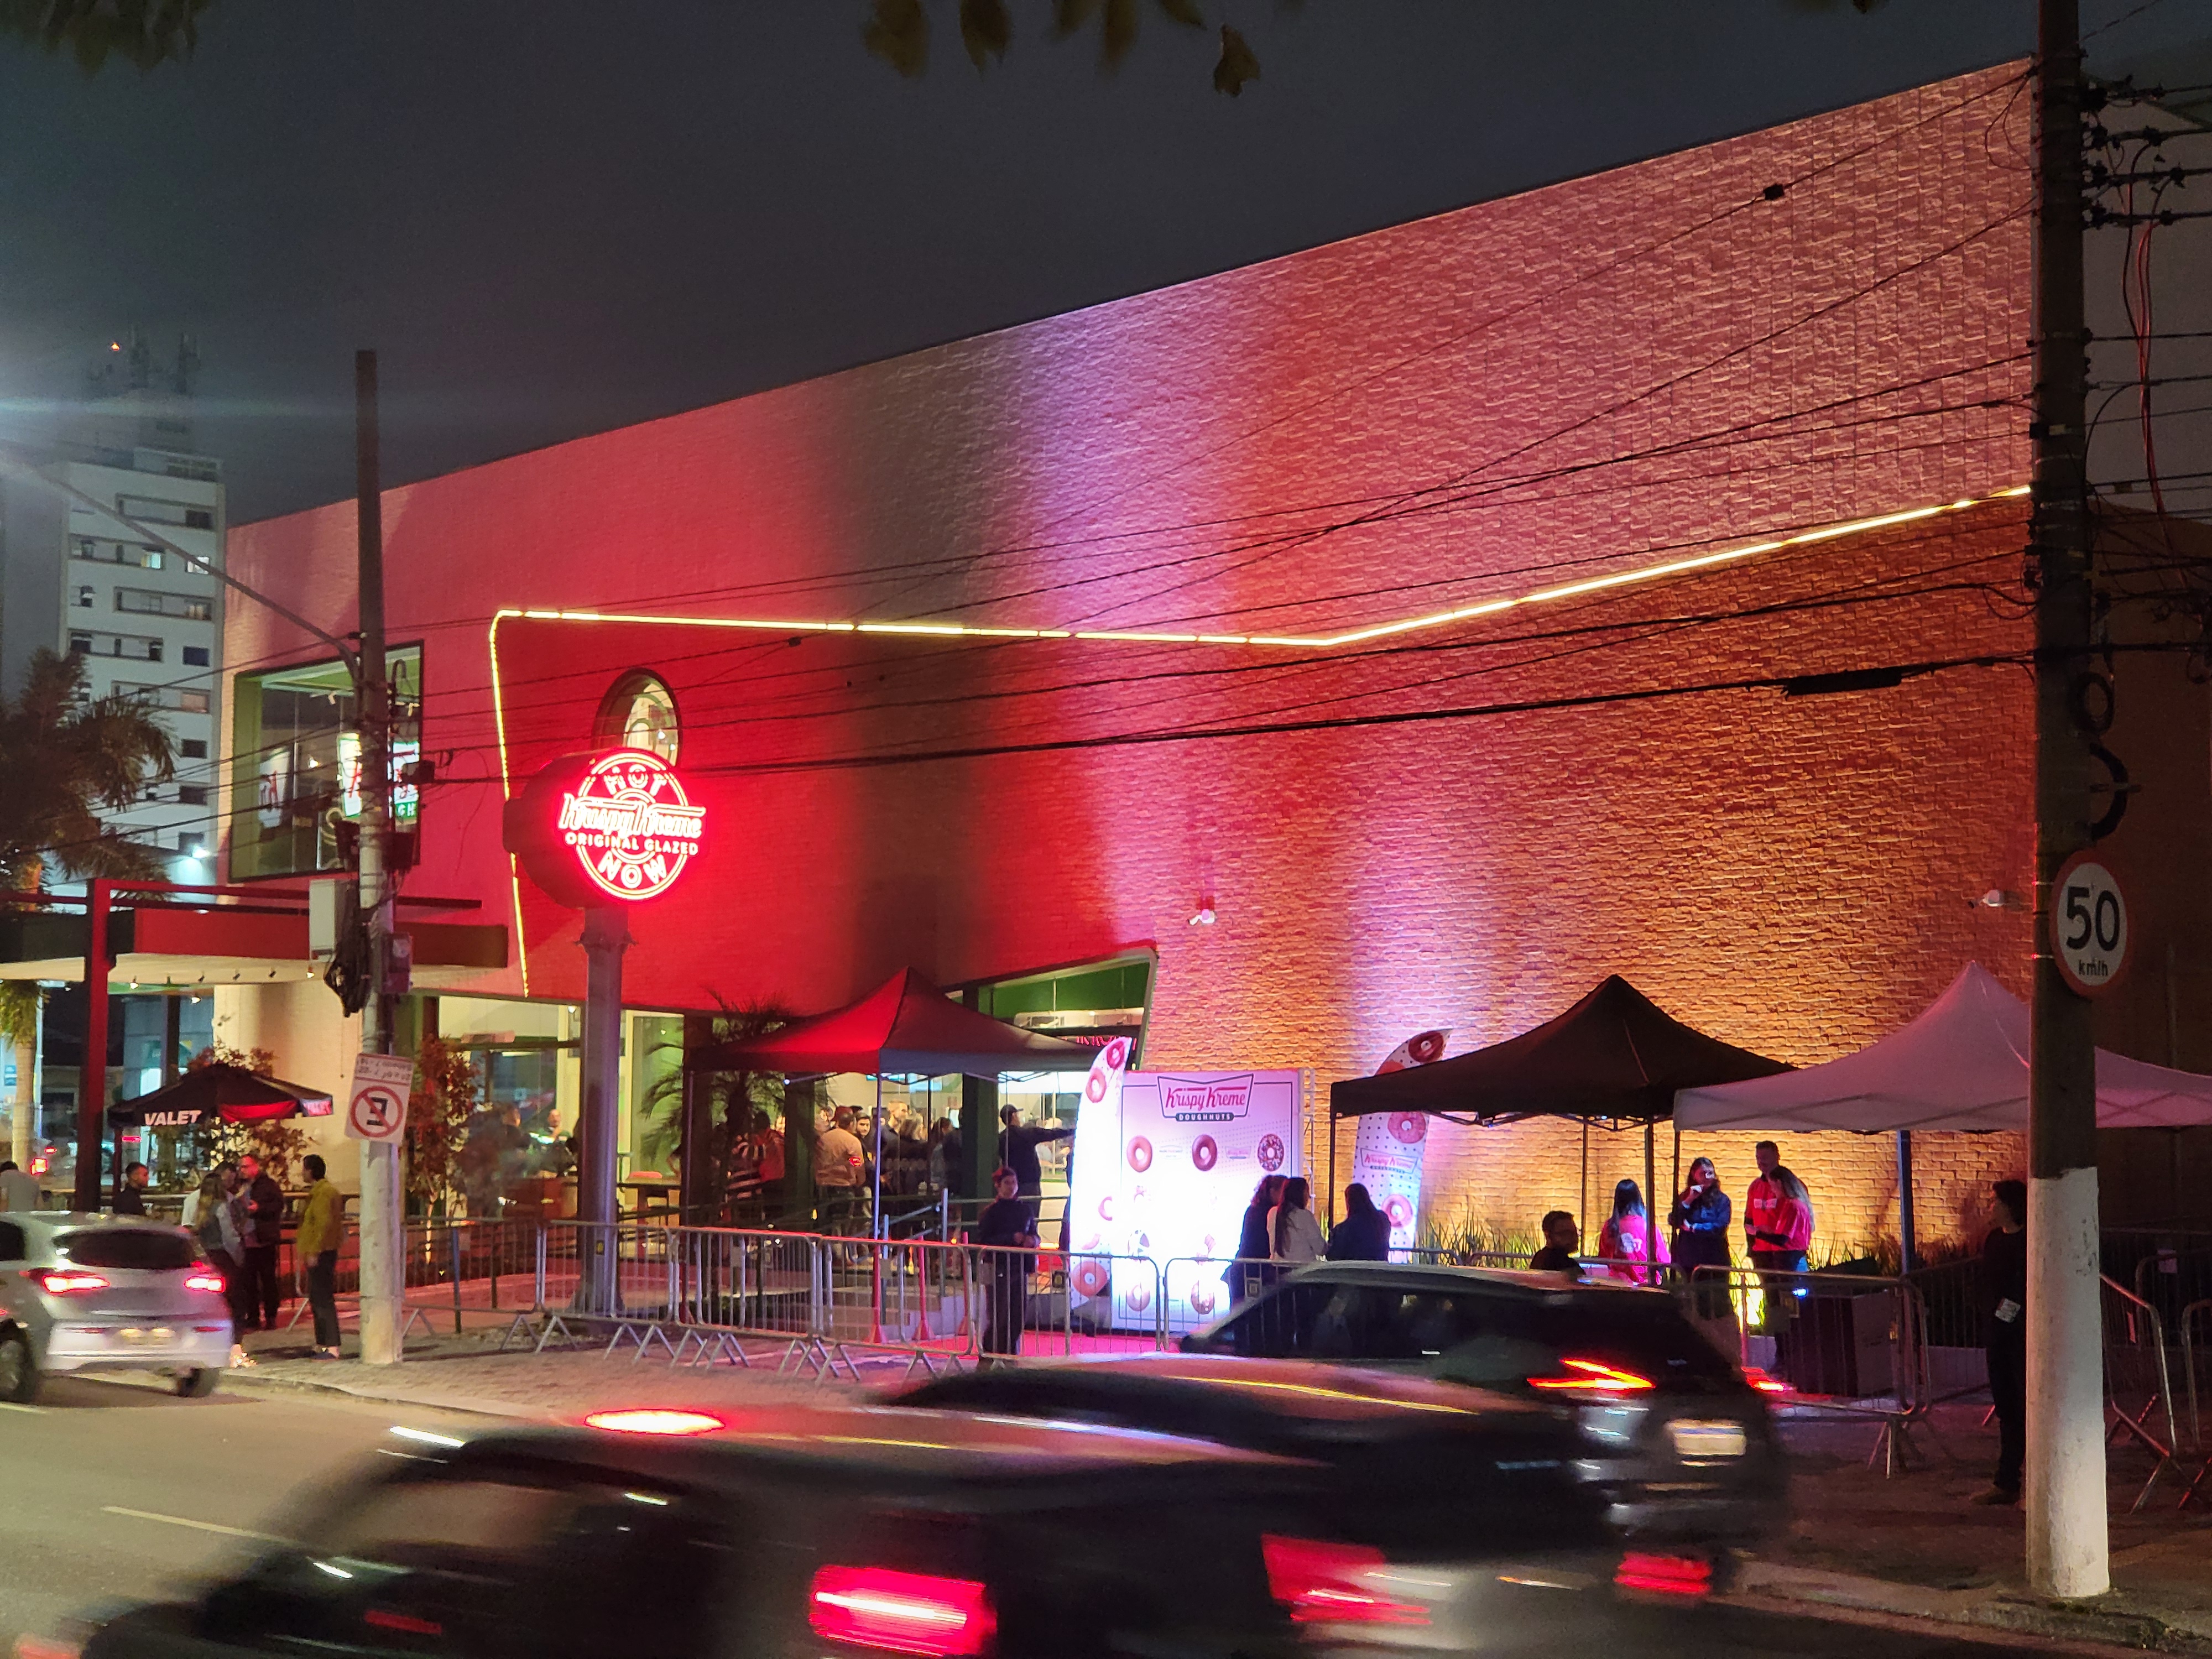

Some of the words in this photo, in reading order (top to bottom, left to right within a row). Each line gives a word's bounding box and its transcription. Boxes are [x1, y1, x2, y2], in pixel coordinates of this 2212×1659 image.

[603, 764, 667, 797] HOT
[559, 792, 638, 839] Krispy
[633, 801, 706, 839] Kreme
[565, 832, 639, 851] ORIGINAL
[644, 839, 698, 856] GLAZED
[598, 850, 667, 889] NOW
[2066, 886, 2120, 951] 50
[2078, 959, 2108, 976] km/h
[1166, 1087, 1207, 1111] Krispy
[1206, 1087, 1247, 1108] Kreme
[144, 1110, 202, 1125] VALET
